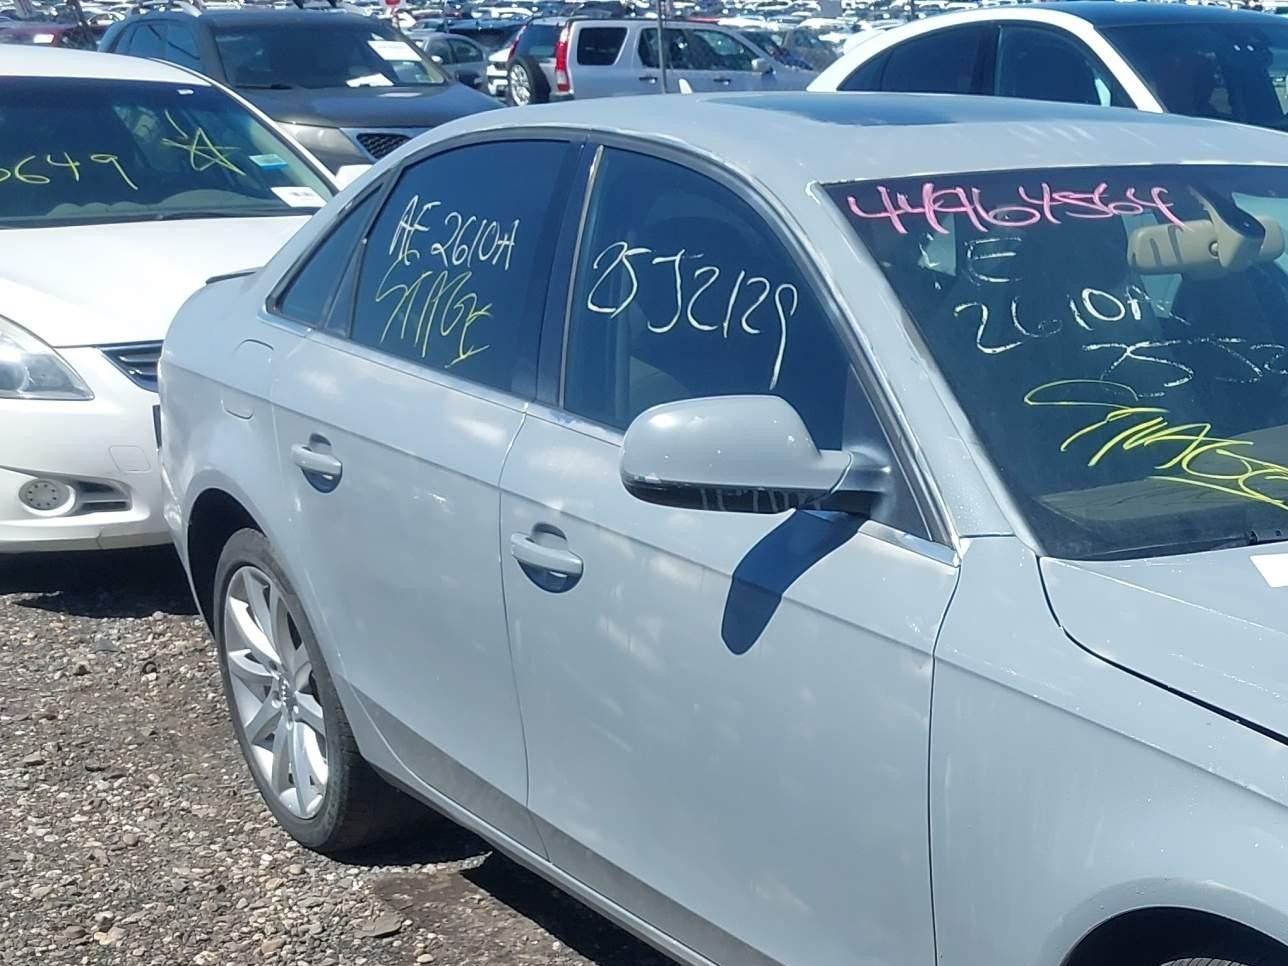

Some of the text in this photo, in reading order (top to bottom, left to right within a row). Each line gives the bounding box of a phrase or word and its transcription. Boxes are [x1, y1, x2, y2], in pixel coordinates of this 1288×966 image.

[389, 194, 520, 271] AE 2610A
[846, 181, 1186, 235] 44964564
